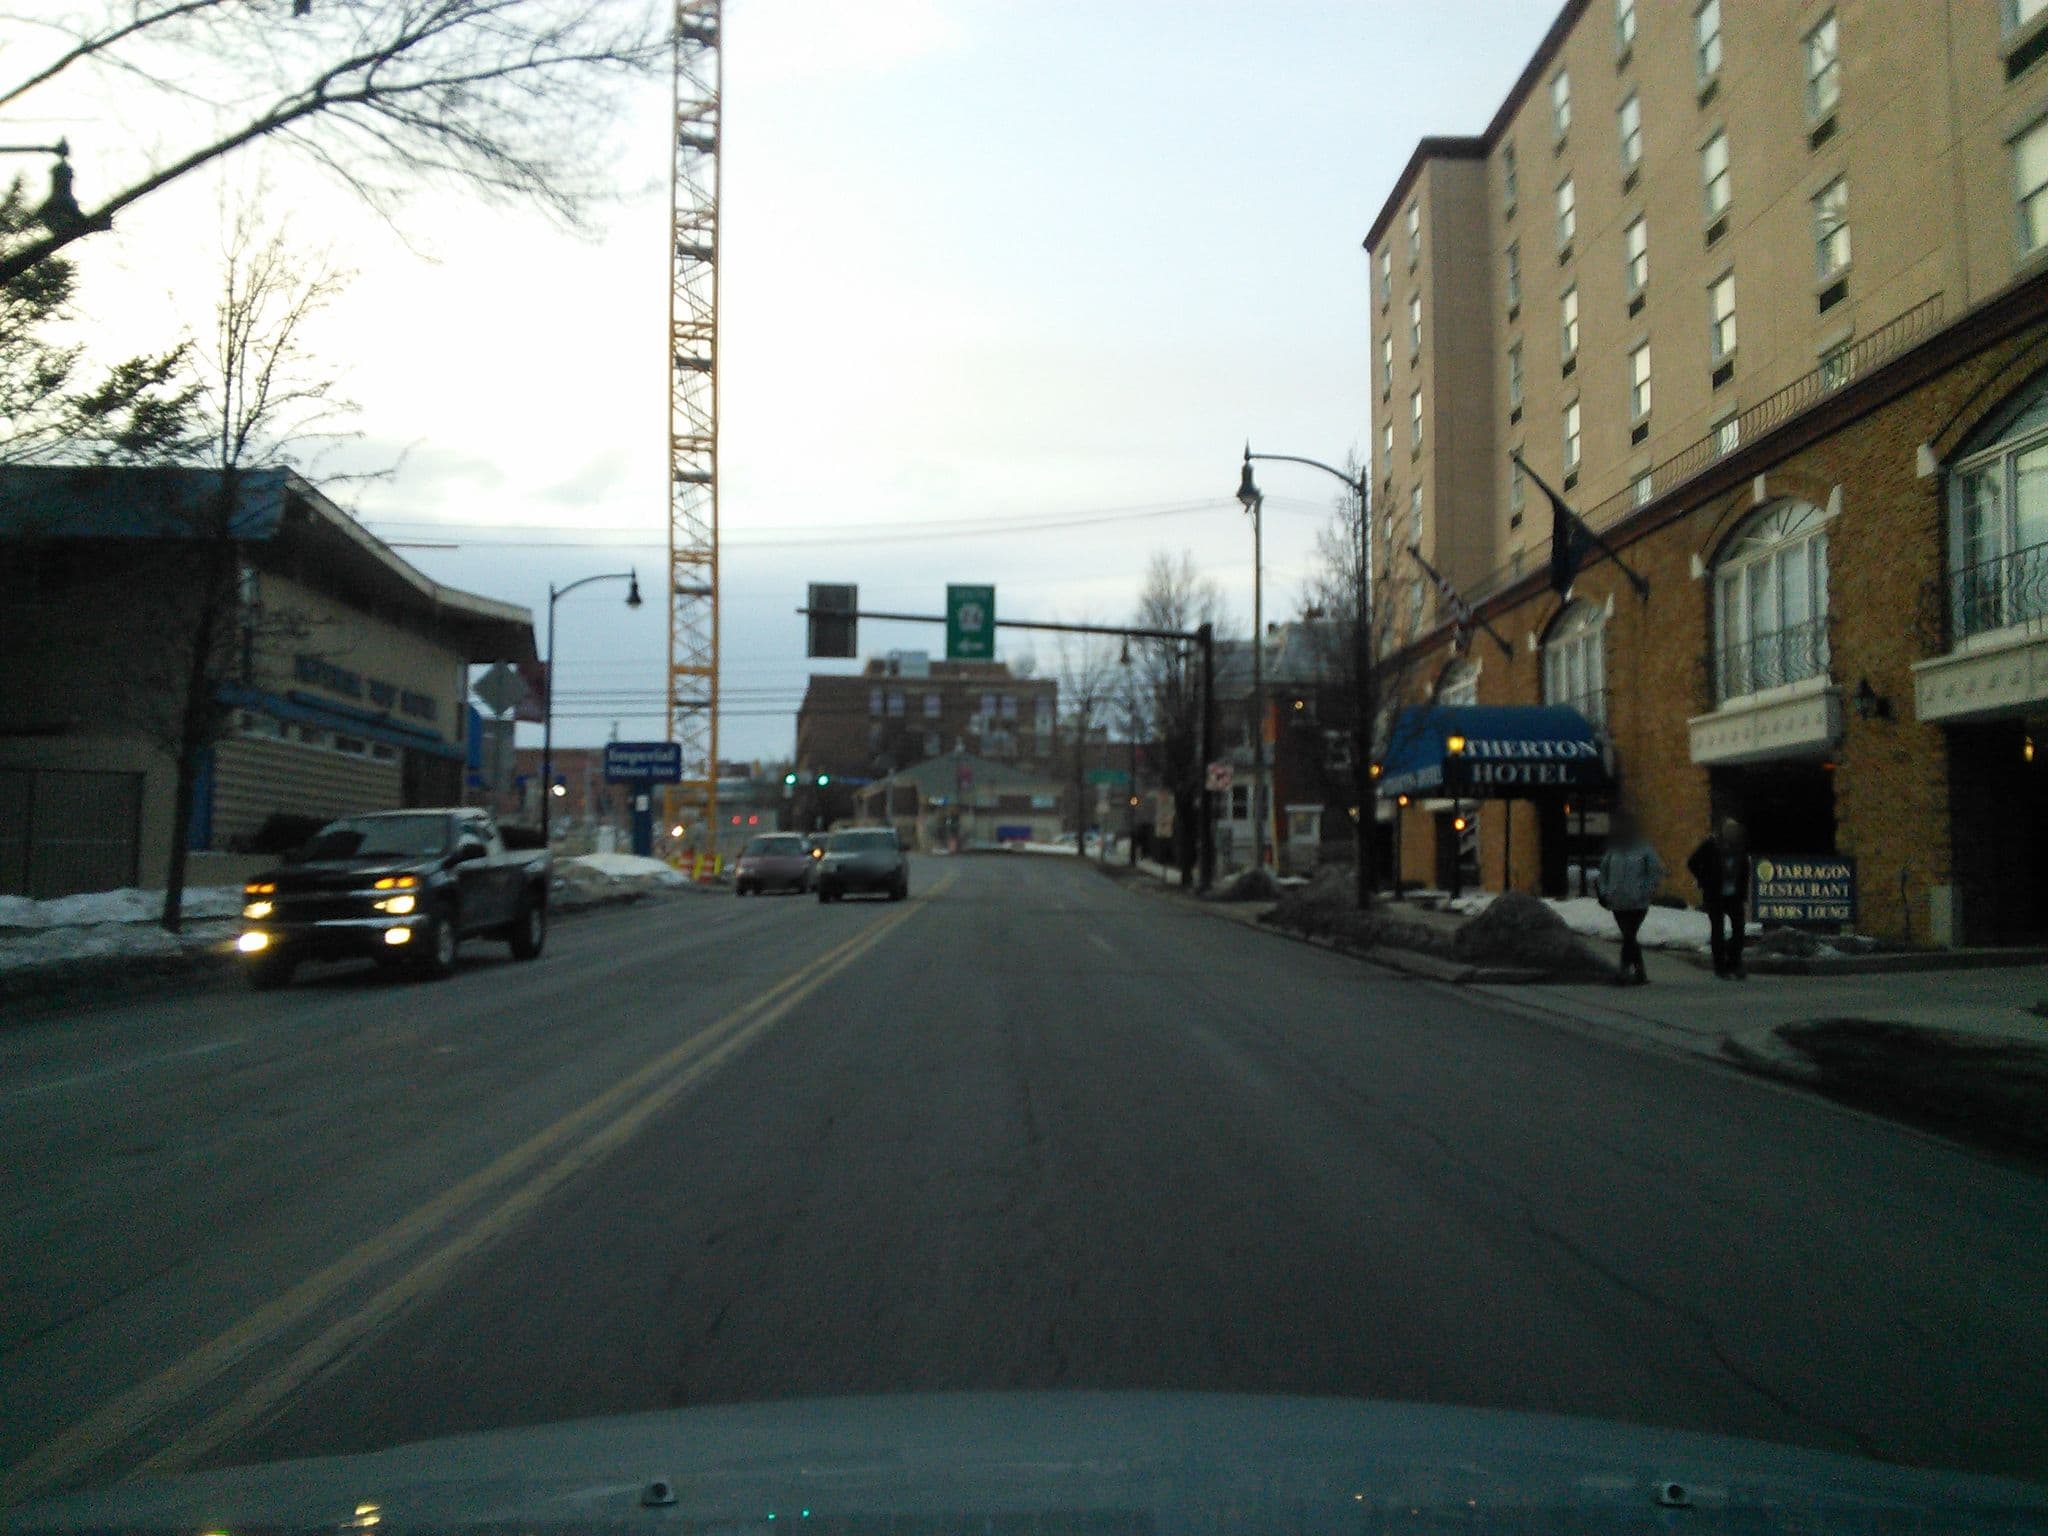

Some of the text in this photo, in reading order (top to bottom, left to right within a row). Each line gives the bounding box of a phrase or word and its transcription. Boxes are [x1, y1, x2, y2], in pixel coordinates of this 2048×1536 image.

[1460, 738, 1598, 757] THERTON
[1473, 763, 1577, 783] HOTEL
[1775, 863, 1850, 879] TARRAGON
[1758, 881, 1849, 897] RESTAURANT
[1807, 903, 1849, 919] LOUNGE
